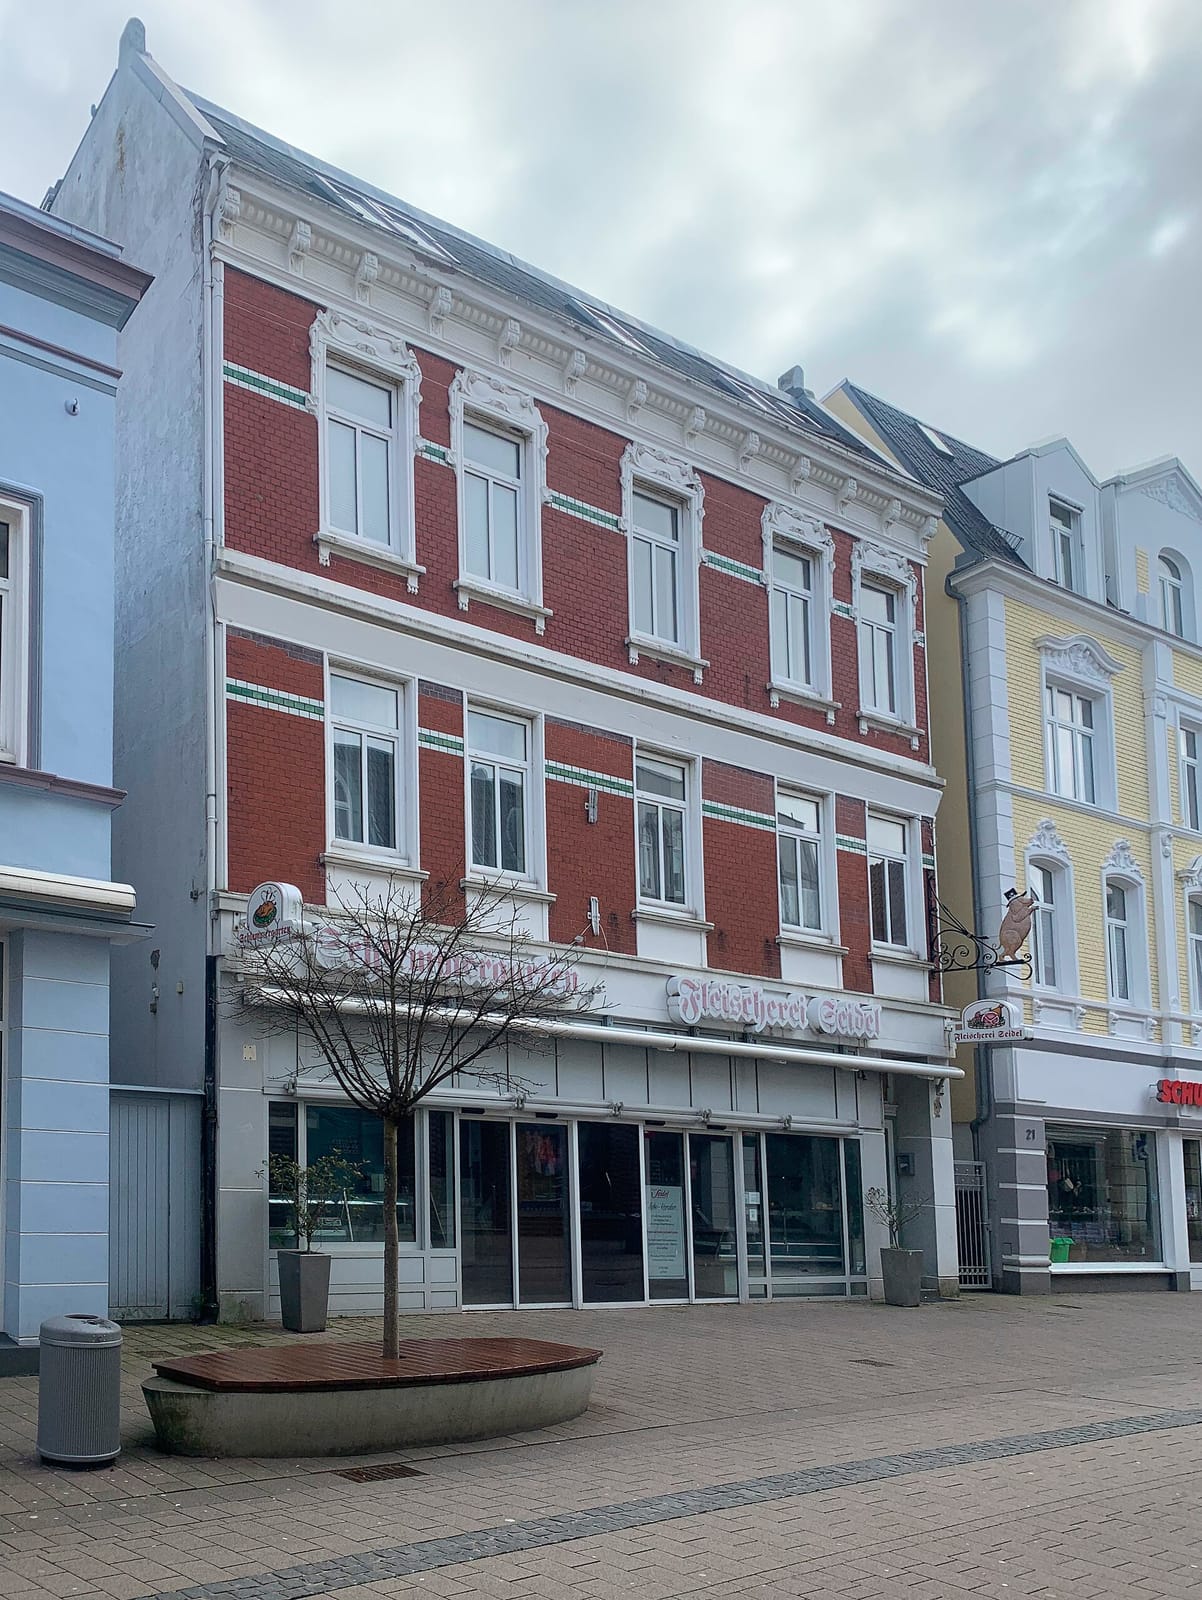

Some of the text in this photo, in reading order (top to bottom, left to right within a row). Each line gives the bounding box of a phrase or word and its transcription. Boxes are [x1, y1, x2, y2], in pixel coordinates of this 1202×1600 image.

[676, 976, 881, 1039] Fleischerei Seidel
[954, 1029, 1023, 1041] Fleischerei Seidel
[1025, 1129, 1036, 1141] 21
